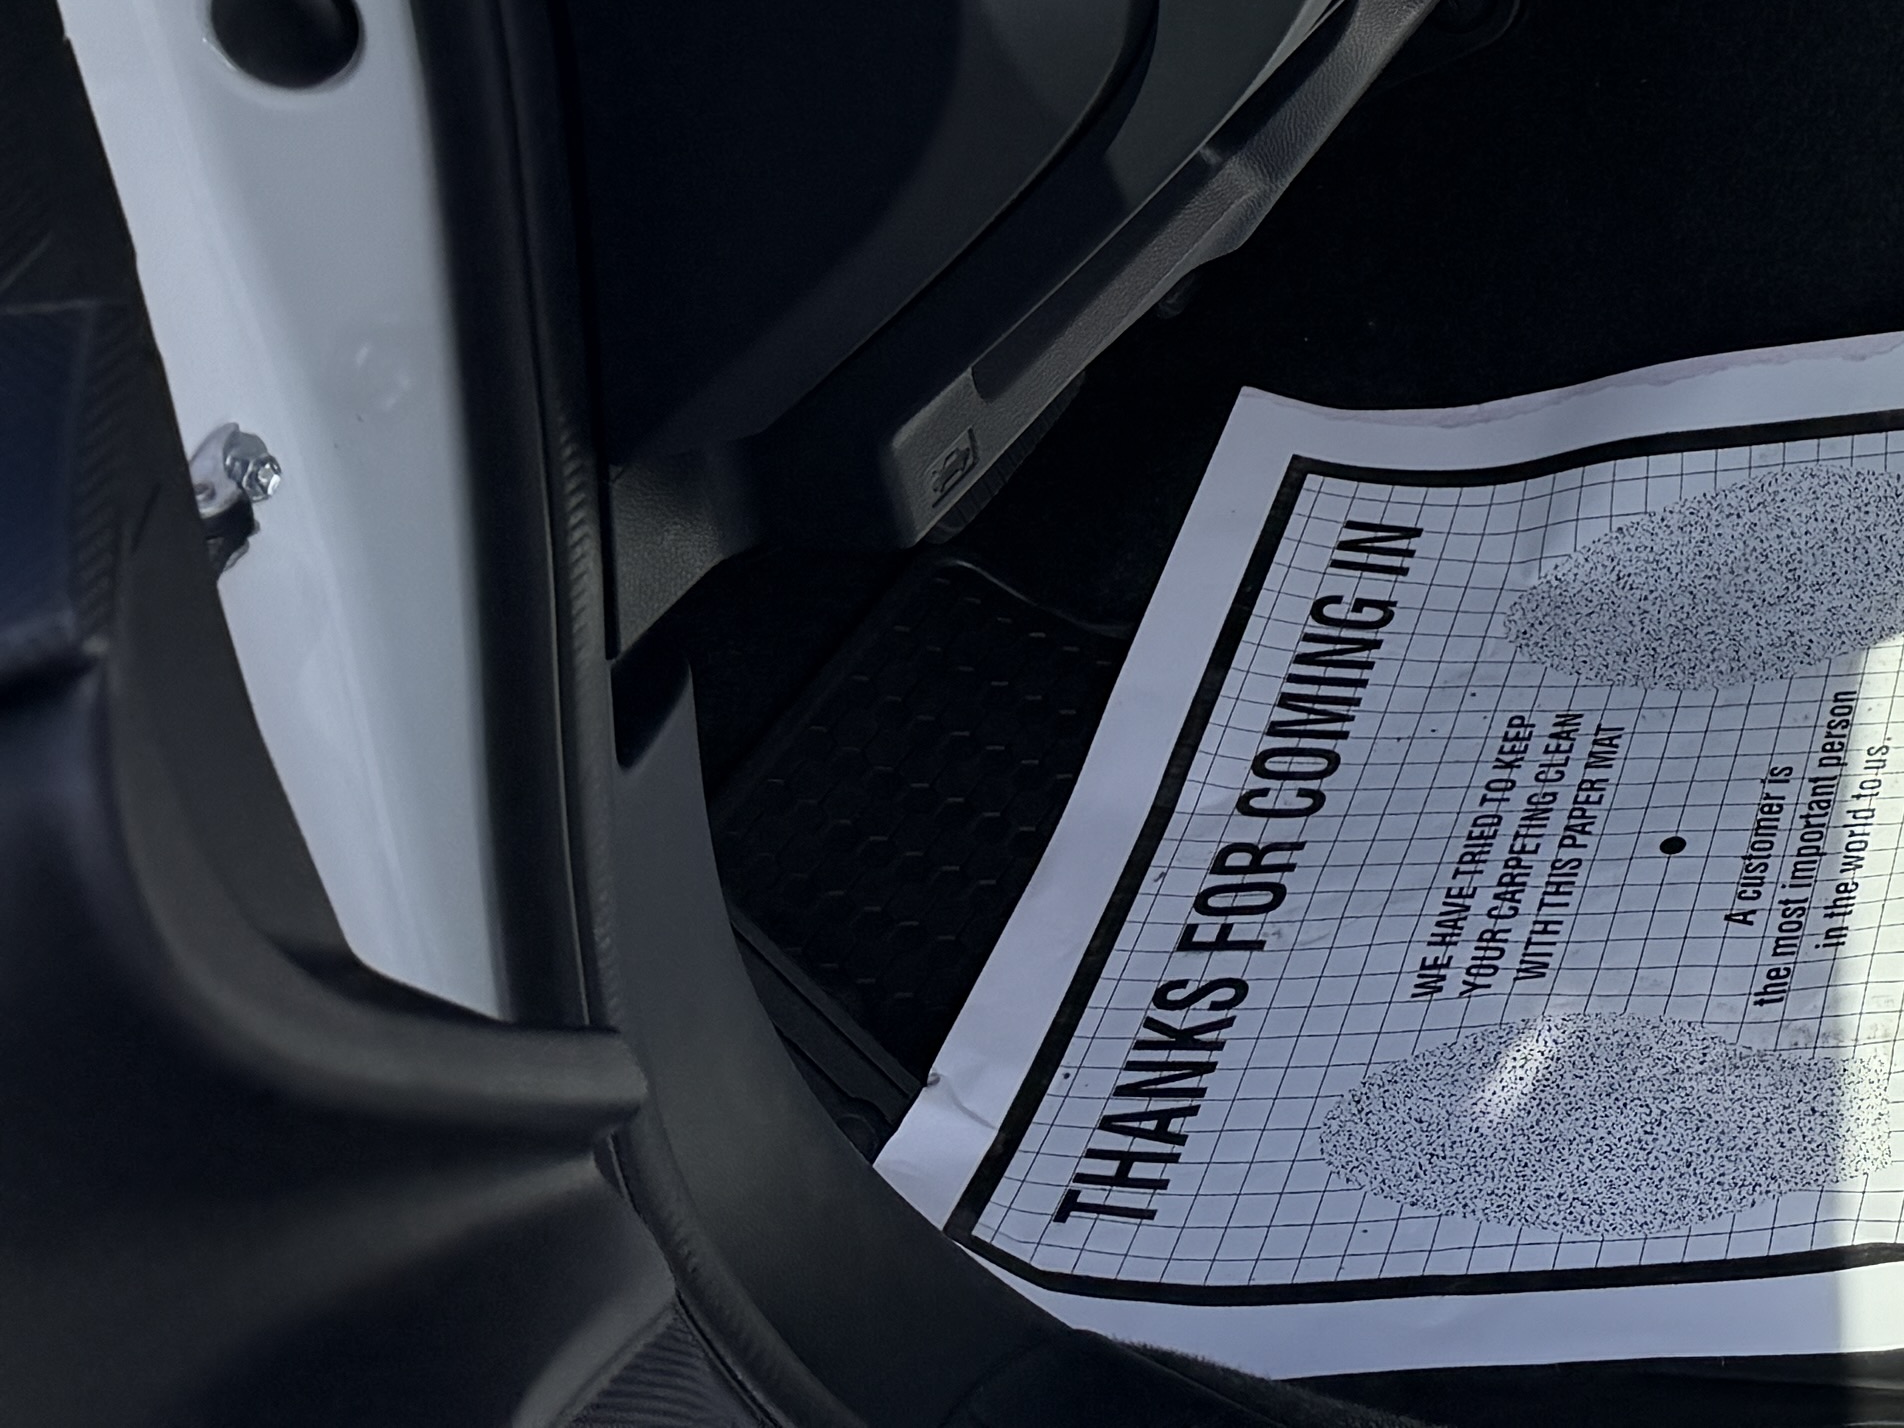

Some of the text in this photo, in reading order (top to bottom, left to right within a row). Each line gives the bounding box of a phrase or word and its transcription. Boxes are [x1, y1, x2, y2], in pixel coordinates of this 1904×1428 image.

[1053, 519, 1424, 1224] THANKS FOR COMING IN
[1410, 714, 1536, 999] WE HAVE TRIED TO KEEP
[1458, 713, 1584, 997] YOUR CARPETING CLEAN
[1513, 723, 1625, 982] WITH THIS PAPER MAT
[1723, 765, 1794, 927] A customer is
[1752, 690, 1859, 1008] the most important person
[1814, 736, 1893, 951] in the world to us.
